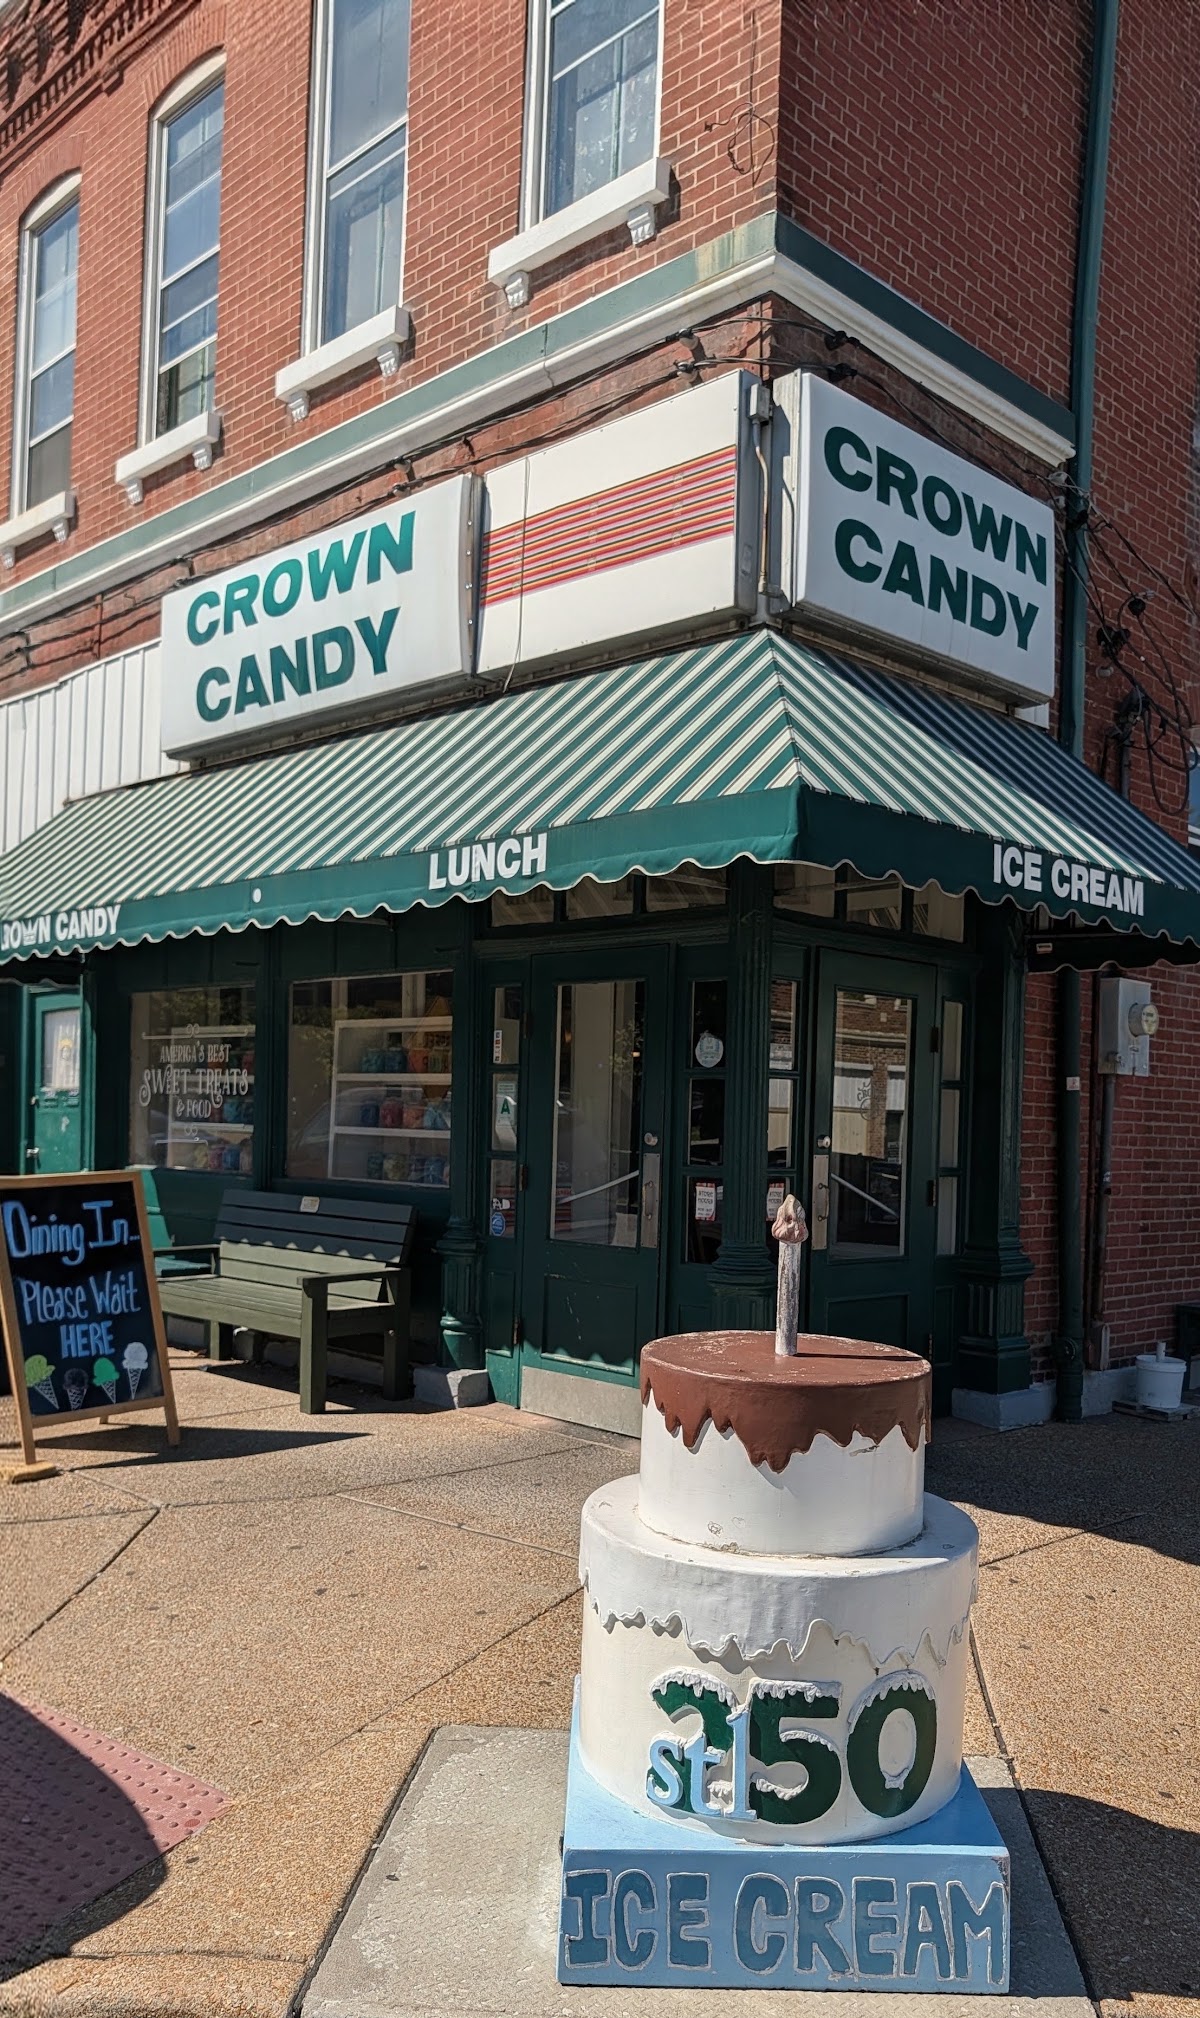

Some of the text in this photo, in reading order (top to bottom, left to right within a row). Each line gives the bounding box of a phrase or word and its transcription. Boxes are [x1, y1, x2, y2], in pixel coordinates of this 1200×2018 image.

[824, 426, 1047, 587] CROWN
[187, 510, 416, 647] CROWN
[835, 518, 1040, 652] CANDY
[196, 606, 401, 723] CANDY
[428, 832, 548, 890] LUNCH
[993, 843, 1145, 917] ICE CREAM
[56, 904, 121, 942] CANDY
[160, 1040, 232, 1063] AMERICA'S BEST
[139, 1063, 249, 1109] SWEET TREATS
[186, 1099, 212, 1119] FOOD
[500, 1098, 511, 1115] A
[1, 1200, 85, 1266] Dining
[18, 1271, 141, 1326] Please Wait
[60, 1320, 115, 1359] HERE
[646, 1705, 758, 1821] stl
[563, 1868, 1008, 1987] ICE CREAM
